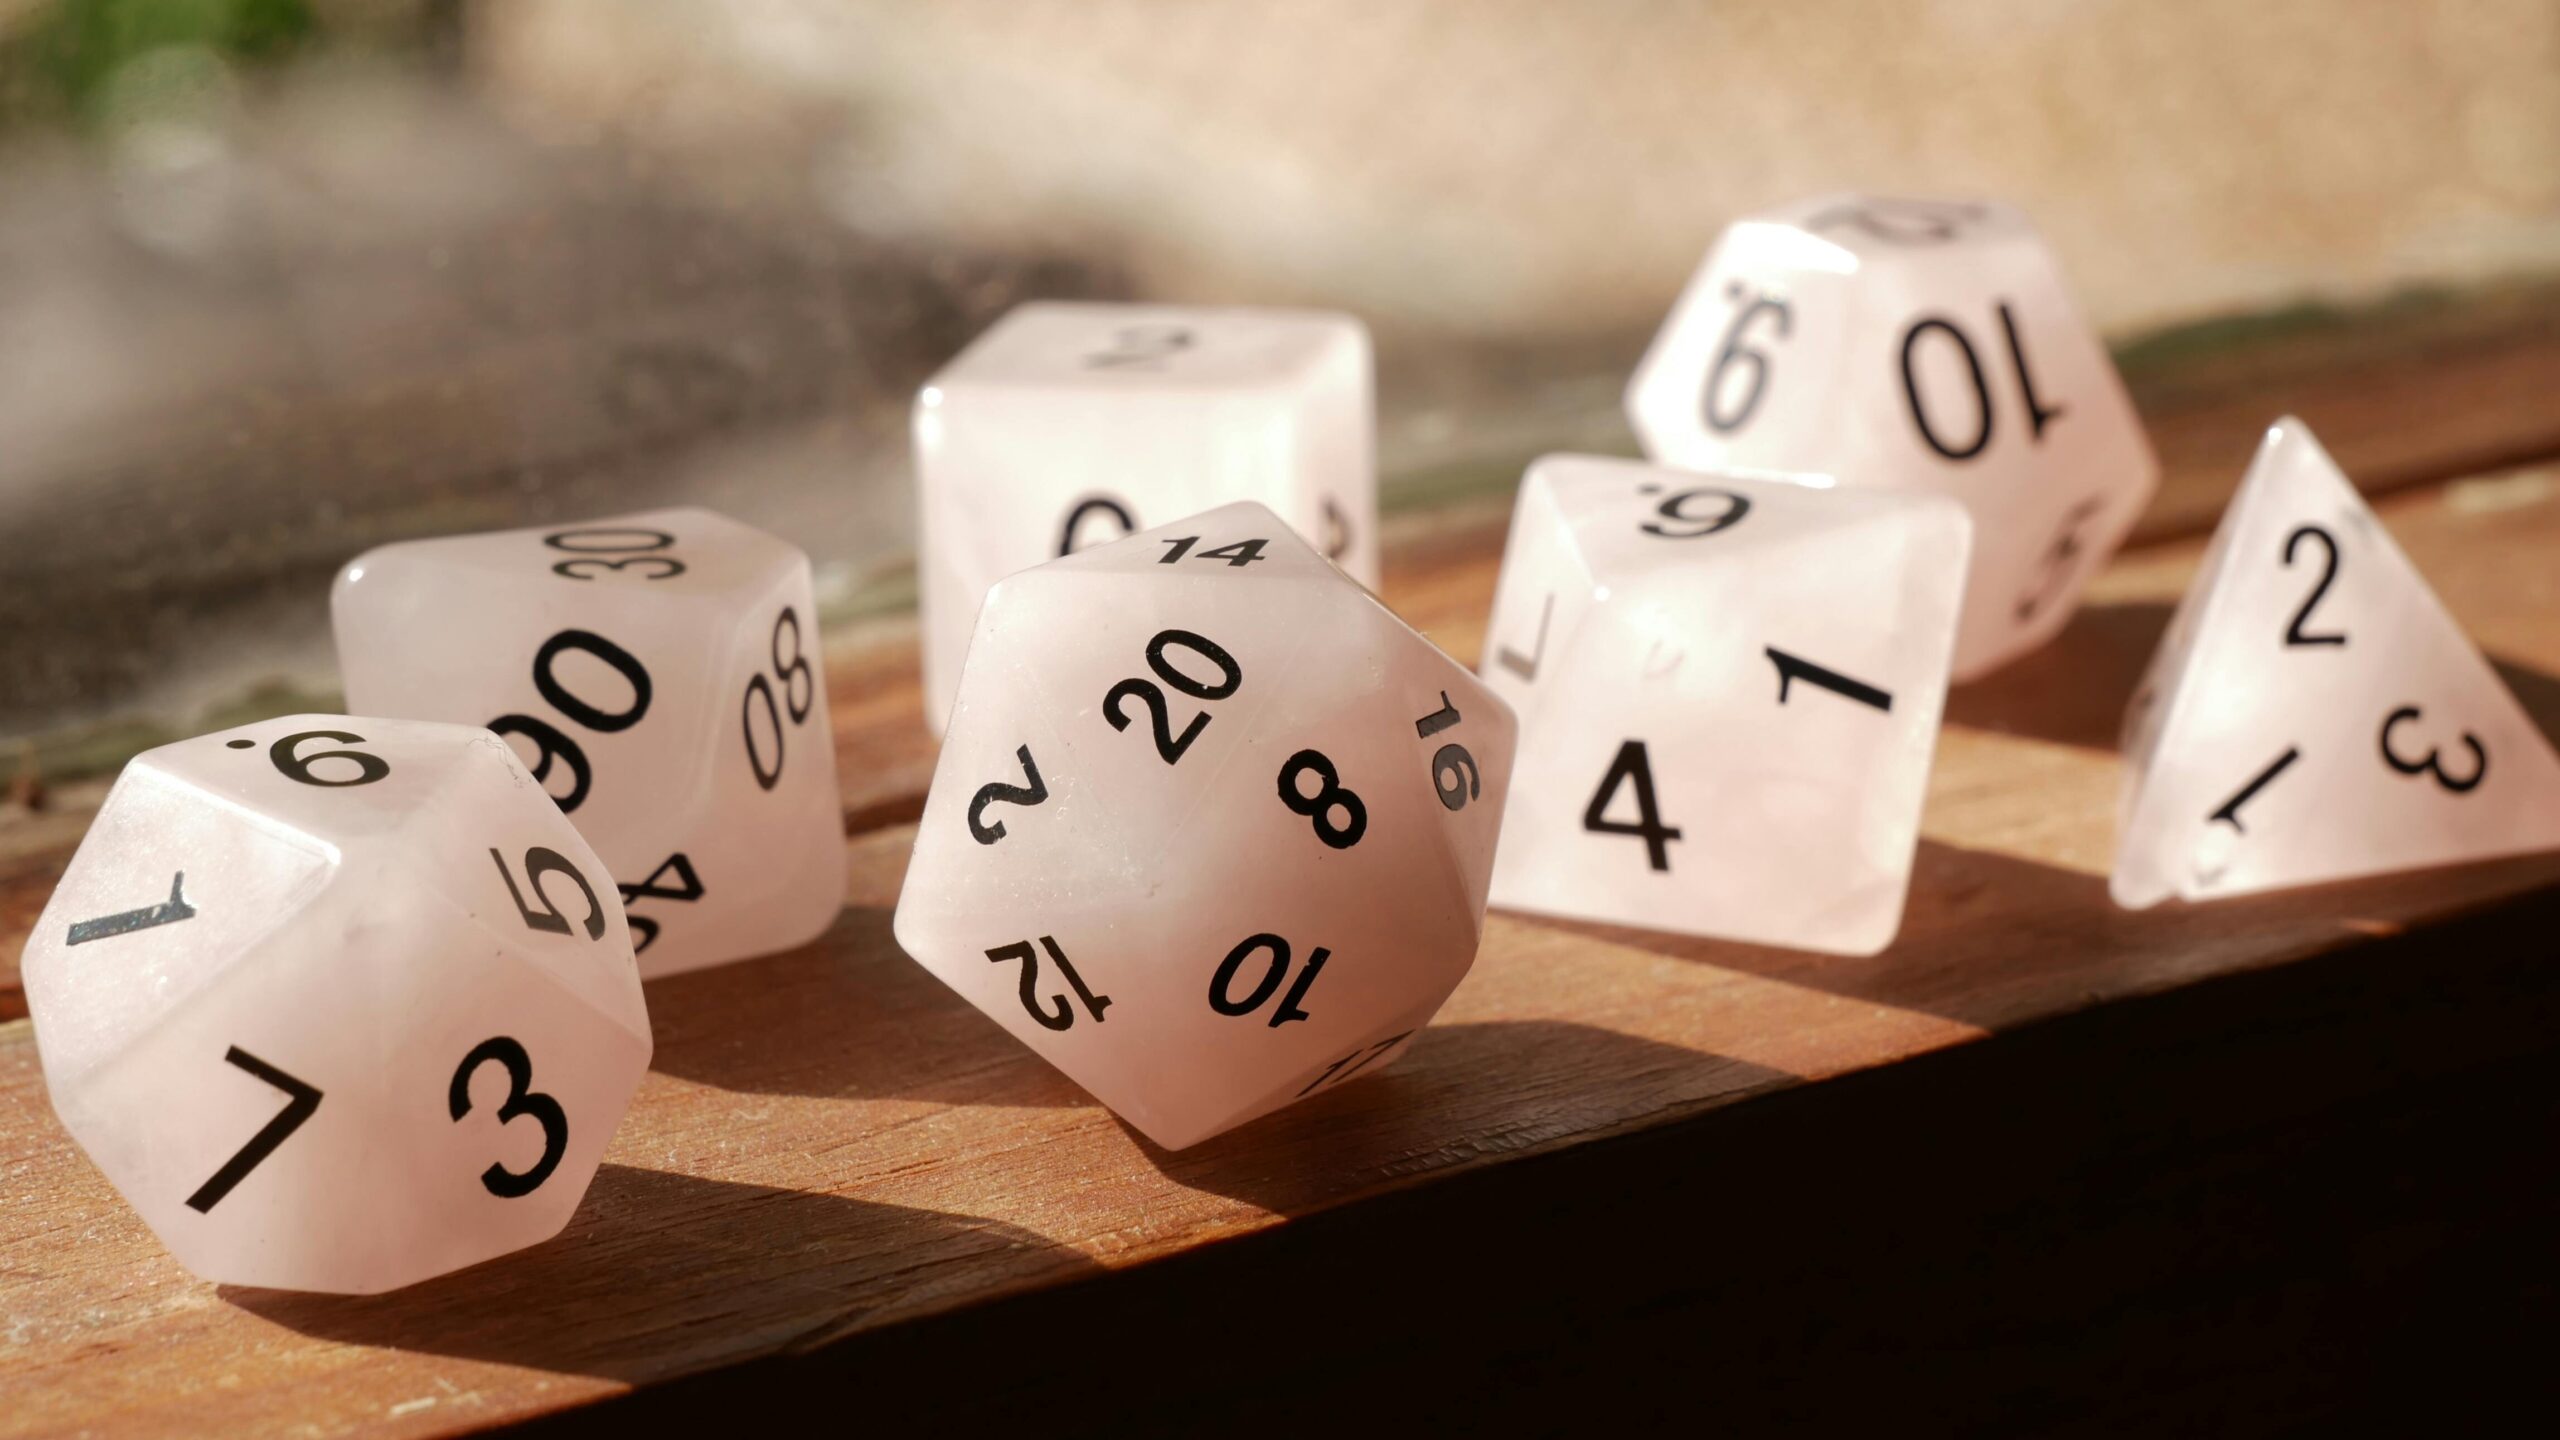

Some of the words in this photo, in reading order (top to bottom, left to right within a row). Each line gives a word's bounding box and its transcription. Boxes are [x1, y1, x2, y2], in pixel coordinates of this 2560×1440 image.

[1898, 298, 2066, 464] 10
[543, 528, 686, 581] 30
[1158, 535, 1270, 568] 14
[2283, 525, 2347, 647] 2
[486, 629, 653, 816] 90
[741, 606, 813, 793] 80
[1102, 629, 1242, 766] 20
[1764, 644, 1895, 713] 1
[967, 743, 1049, 846] 2
[1277, 748, 1368, 850] 8
[1414, 690, 1481, 812] 16
[2206, 745, 2301, 835] 1
[2379, 705, 2489, 795] 3
[1582, 739, 1682, 873] 4
[66, 870, 196, 946] 1
[489, 846, 606, 942] 5
[984, 935, 1113, 1032] 12
[1208, 932, 1332, 1029] 10
[184, 1045, 325, 1215] 7
[448, 1035, 569, 1199] 3
